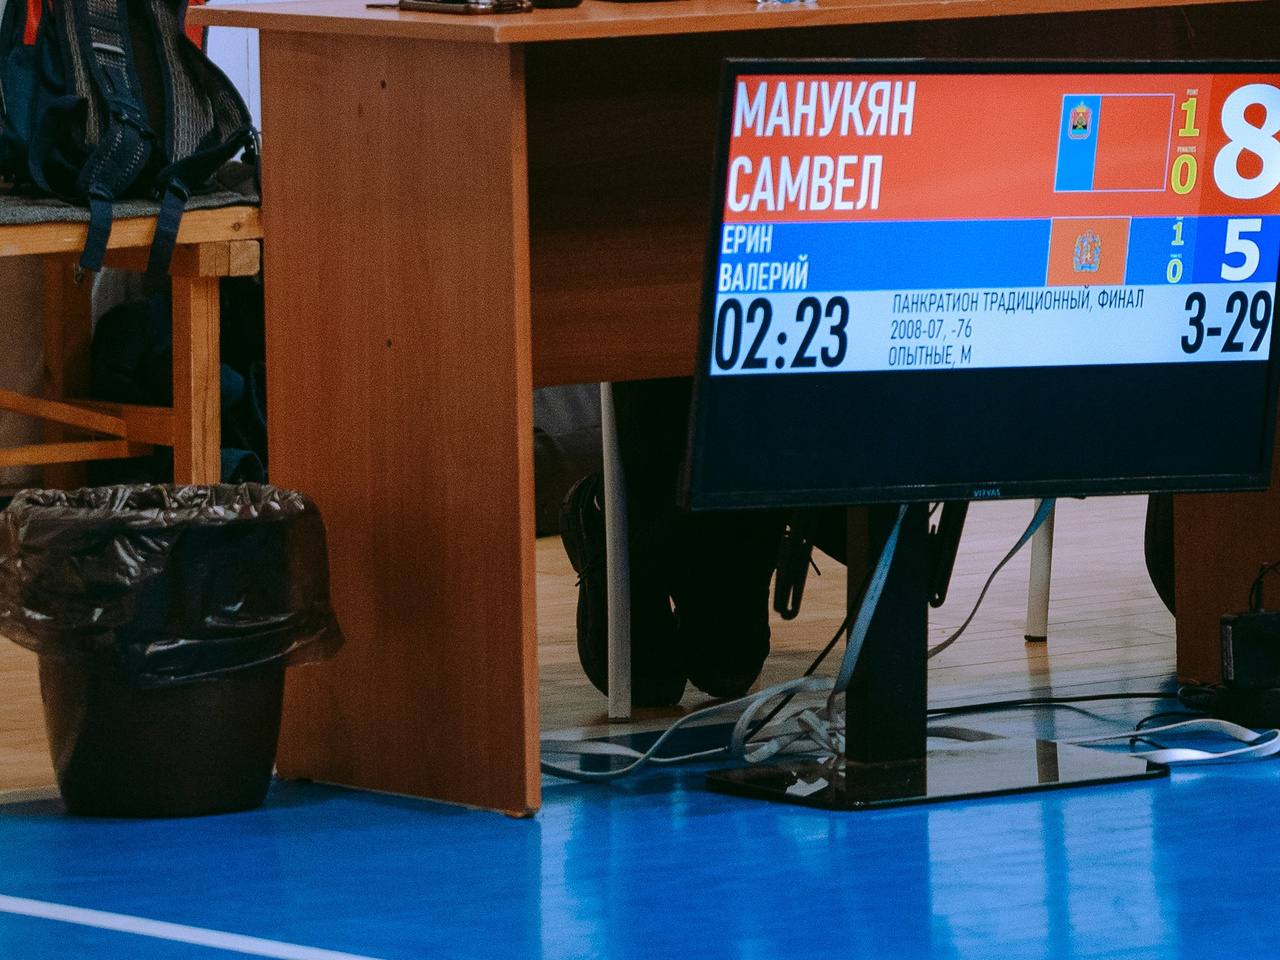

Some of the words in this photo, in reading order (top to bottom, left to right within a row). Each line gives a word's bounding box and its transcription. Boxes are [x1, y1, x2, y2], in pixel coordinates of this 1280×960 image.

[733, 81, 917, 137] МАНУКЯН
[1178, 97, 1199, 136] 1
[728, 155, 883, 212] САМВЕЛ
[1171, 154, 1197, 194] 0
[722, 224, 774, 254] ЕРИН
[1171, 221, 1184, 245] 1
[1221, 218, 1262, 281] 5
[718, 254, 809, 291] ВАЛЕРИЙ
[1166, 258, 1183, 283] 0
[892, 292, 978, 313] ПАНКРАТИОН
[983, 286, 1094, 314] ТРАДИЦИОННЫЙ,
[1097, 289, 1144, 309] ФИНАЛ
[715, 296, 850, 370] 02:23
[891, 319, 946, 341] 2008-07,
[951, 318, 972, 338] -76
[1181, 290, 1272, 354] 3-29
[888, 346, 956, 368] ОПЫТНЫЕ,
[960, 345, 972, 363] М
